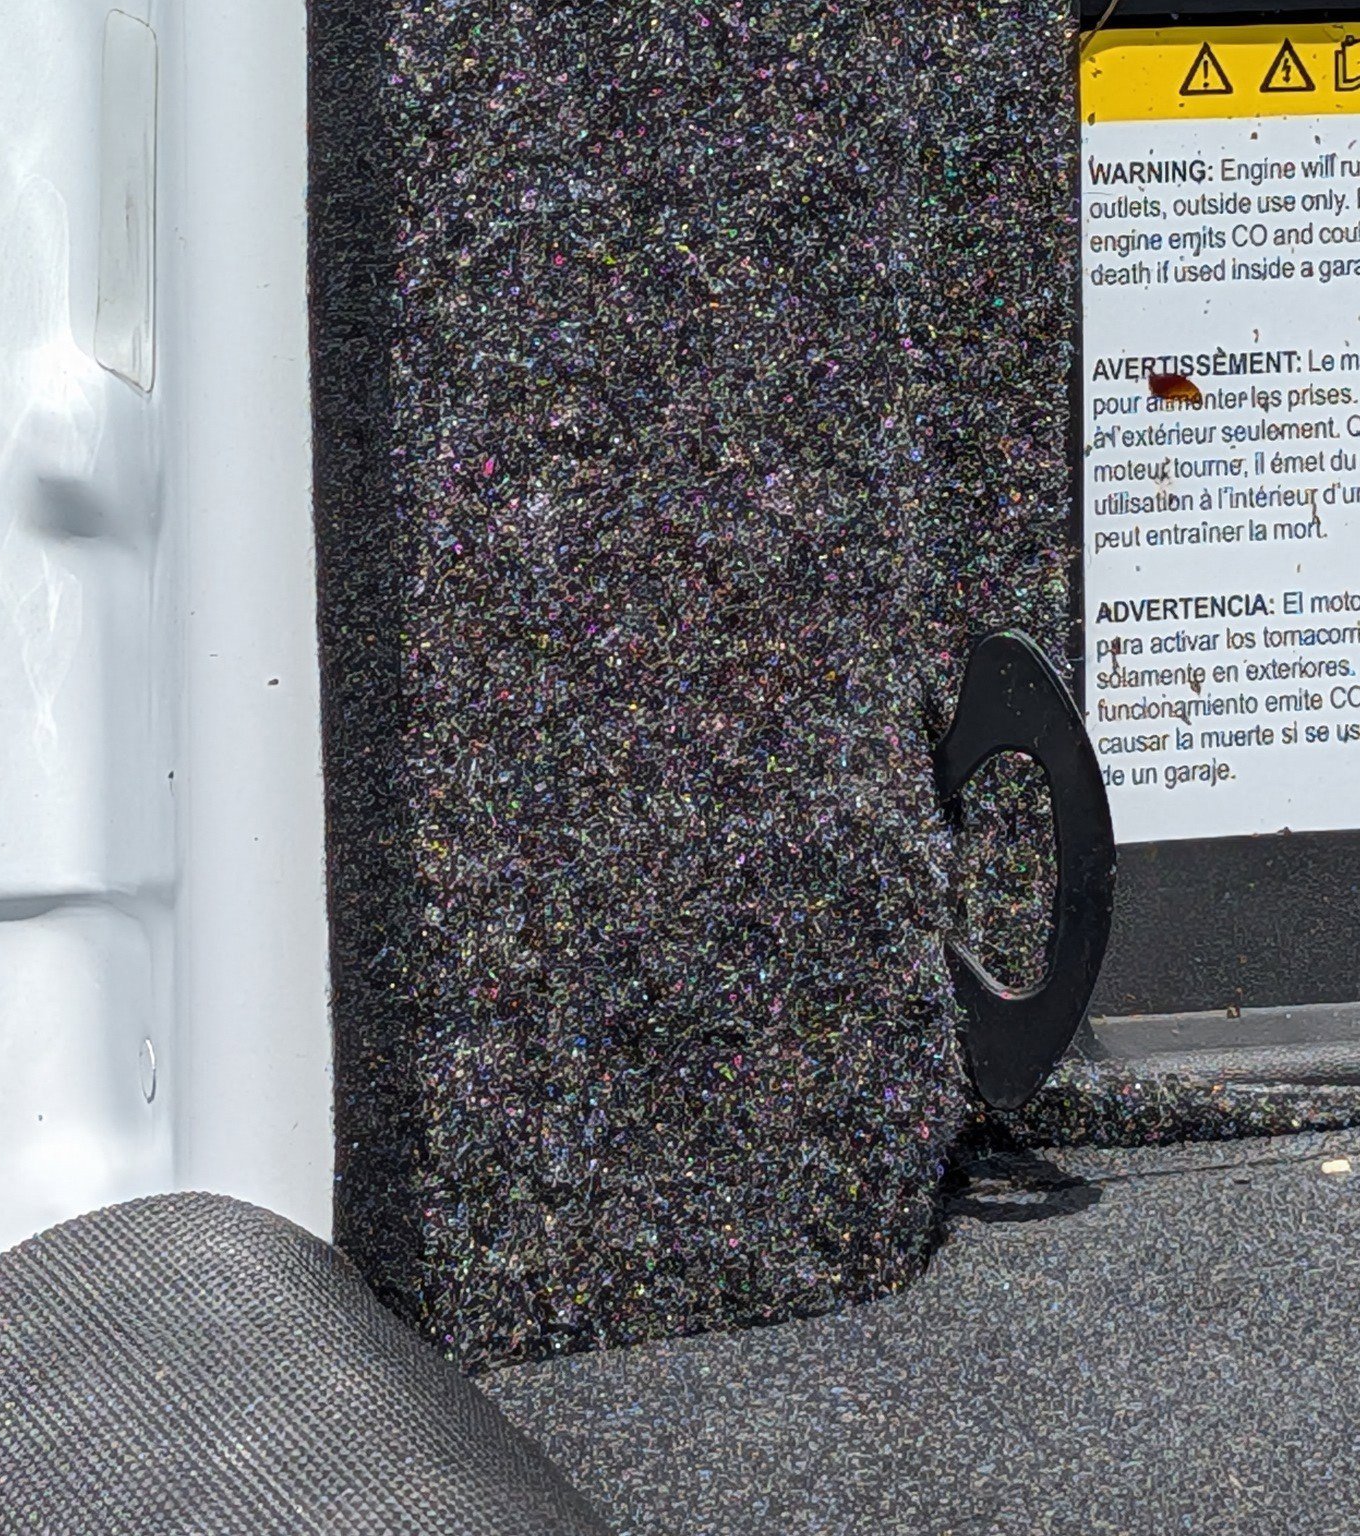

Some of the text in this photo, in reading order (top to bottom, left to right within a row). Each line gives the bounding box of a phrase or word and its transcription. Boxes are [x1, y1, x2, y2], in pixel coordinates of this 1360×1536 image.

[1089, 160, 1214, 185] WARNING:
[1221, 158, 1295, 185] Engine
[1301, 154, 1335, 178] will
[1089, 194, 1167, 219] outlets,
[1173, 191, 1251, 215] outside
[1258, 195, 1295, 213] use
[1302, 191, 1350, 215] only.
[1090, 231, 1162, 257] engine
[1168, 226, 1226, 250] emits
[1232, 223, 1267, 247] CO
[1273, 222, 1313, 245] and
[1090, 262, 1150, 285] death
[1157, 260, 1168, 282] if
[1174, 259, 1225, 281] used
[1231, 257, 1294, 280] inside
[1300, 260, 1313, 277] a
[1308, 350, 1334, 372] Le
[1093, 396, 1141, 420] pour
[1251, 386, 1282, 409] les
[1288, 385, 1358, 412] prises.
[1222, 418, 1340, 441] seulement.
[1094, 460, 1170, 482] moteur
[1174, 458, 1247, 478] tourne,
[1255, 453, 1264, 475] il
[1270, 451, 1325, 474] émet
[1330, 450, 1356, 471] du
[1094, 492, 1193, 515] utilisation
[1199, 488, 1212, 510] à
[1218, 486, 1319, 509] l'intérieur
[1094, 517, 1327, 553] peut entraîner la mort.
[1096, 595, 1274, 623] ADVERTENCIA:
[1283, 592, 1303, 614] El
[1096, 636, 1142, 662] para
[1150, 630, 1220, 654] activar
[1226, 628, 1256, 650] los
[1096, 666, 1205, 689] solamente
[1212, 664, 1238, 683] en
[1246, 656, 1356, 680] exteriores.
[1098, 690, 1258, 722] funcionamiento
[1265, 688, 1322, 711] emite
[1098, 736, 1169, 754] causar
[1175, 728, 1193, 750] la
[1200, 724, 1274, 749] muerte
[1281, 719, 1297, 743] si
[1305, 722, 1329, 742] se
[1132, 766, 1157, 785] un
[1165, 758, 1236, 789] garaje.
